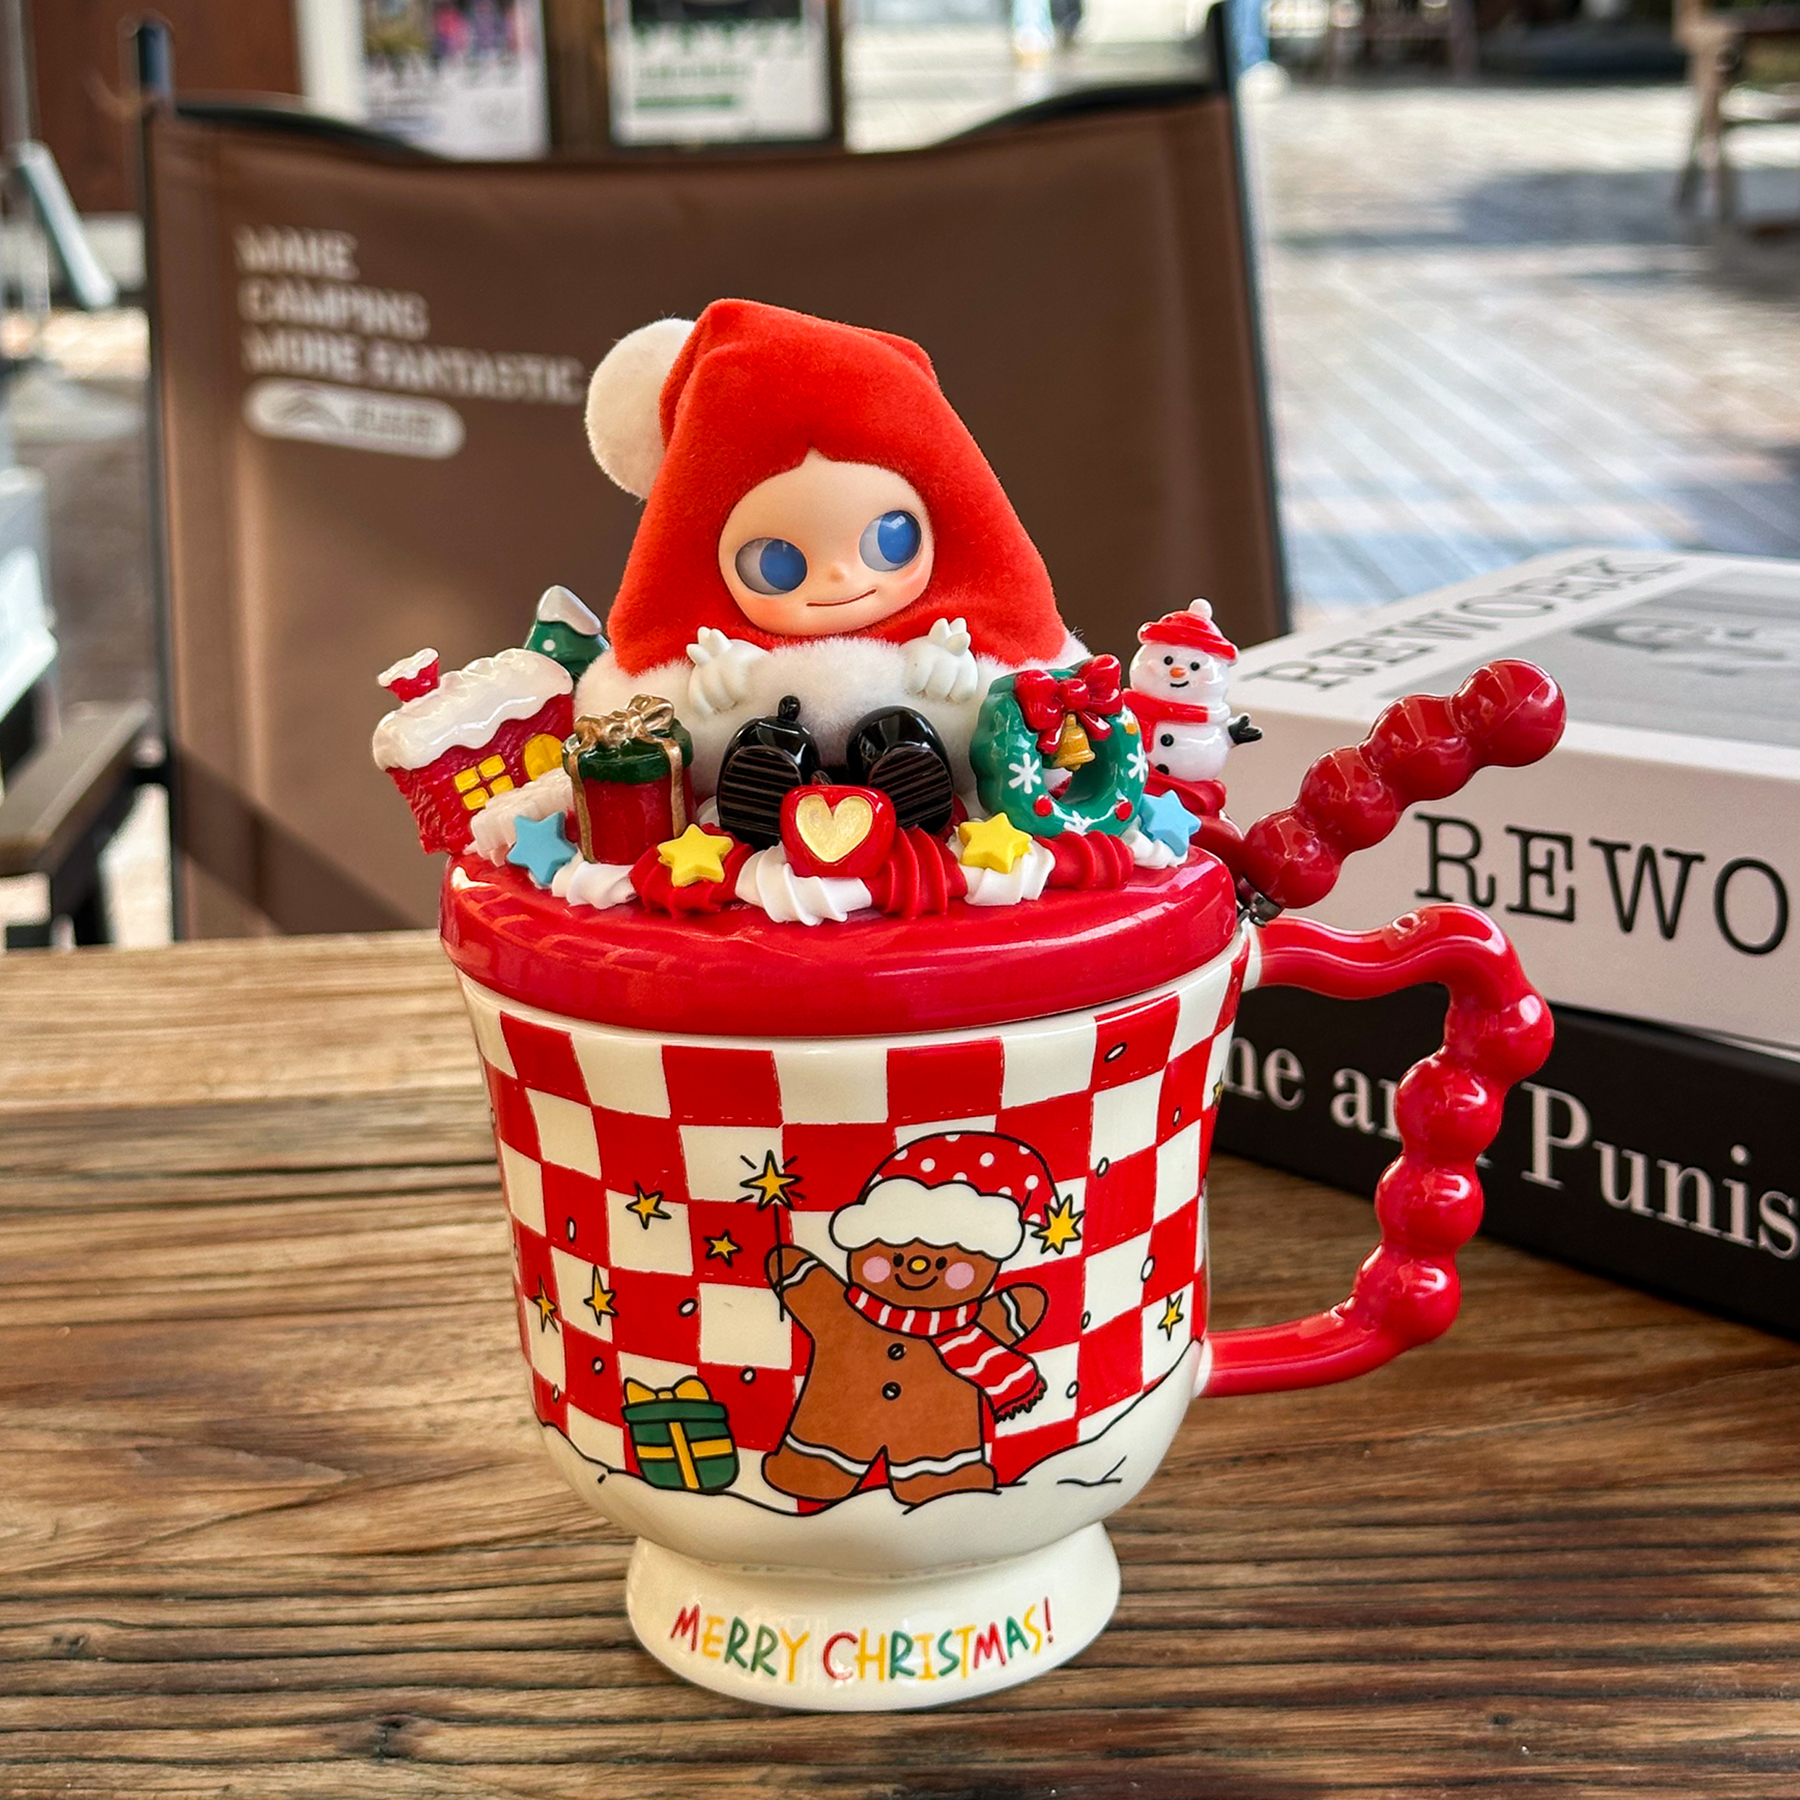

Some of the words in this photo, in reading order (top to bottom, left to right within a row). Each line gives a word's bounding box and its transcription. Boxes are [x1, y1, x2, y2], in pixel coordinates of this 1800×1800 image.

[235, 226, 358, 280] MAKE
[238, 278, 429, 341] CAMPING
[243, 326, 362, 381] MORE
[366, 341, 585, 404] FANTASTIC
[1239, 556, 1685, 690] REWORK
[1413, 811, 1789, 956] REWO
[1520, 1080, 1800, 1260] Punis
[670, 1604, 810, 1683] MERRY
[822, 1597, 1054, 1681] CHRISTMAS!
